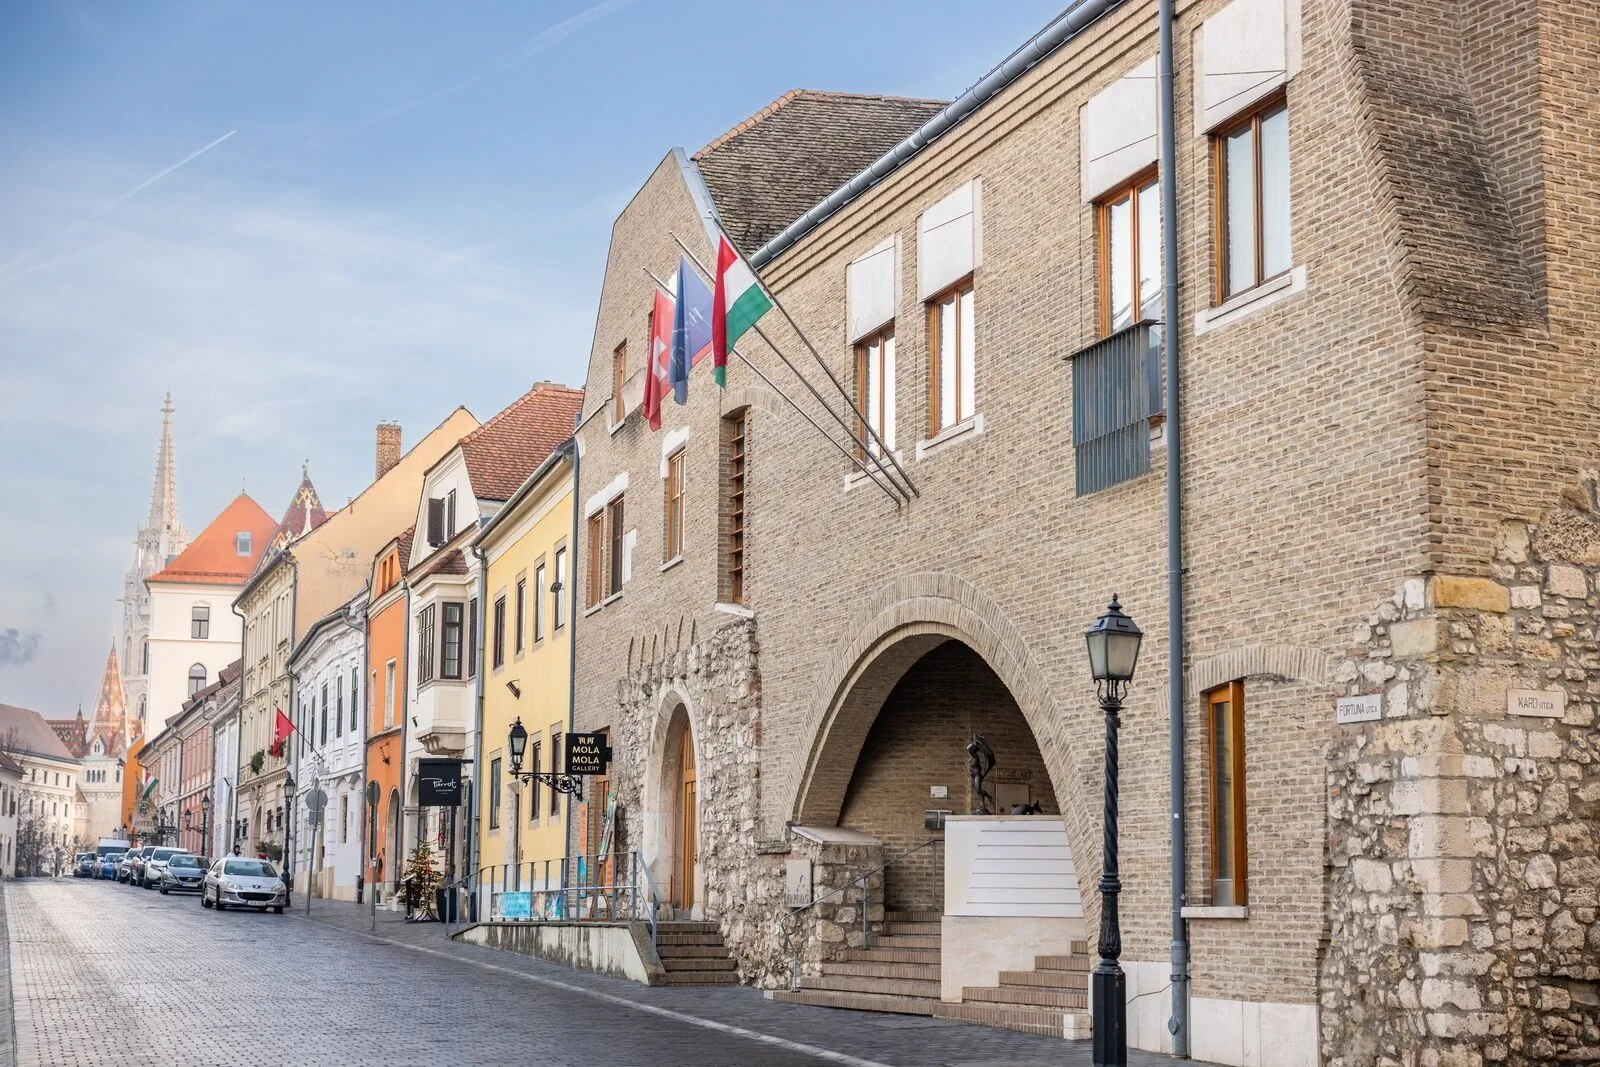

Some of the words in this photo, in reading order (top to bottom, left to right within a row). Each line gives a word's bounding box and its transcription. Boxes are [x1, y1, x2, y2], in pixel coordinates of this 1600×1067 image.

[1518, 696, 1538, 709] KARD
[1539, 701, 1554, 710] UTCA
[1339, 703, 1365, 717] FORTUNA
[1366, 705, 1378, 715] UTCA
[572, 745, 600, 754] MOLA
[572, 756, 600, 764] MOLA
[421, 777, 457, 789] Pierrot
